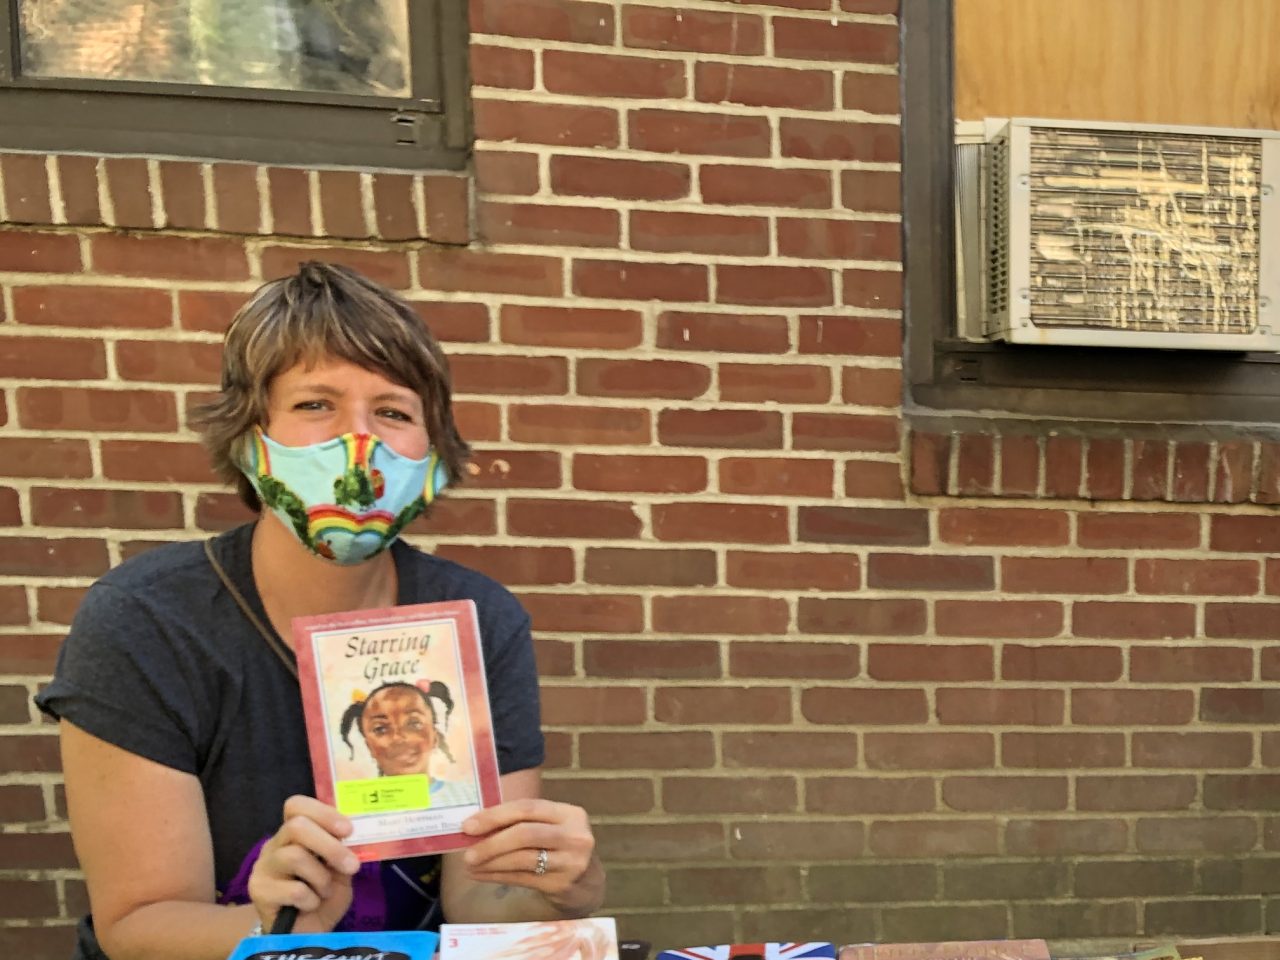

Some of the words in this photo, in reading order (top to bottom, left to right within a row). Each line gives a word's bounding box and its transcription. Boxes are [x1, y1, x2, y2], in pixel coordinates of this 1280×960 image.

[345, 632, 430, 658] Starring
[364, 657, 420, 683] Grace
[449, 938, 458, 948] 3
